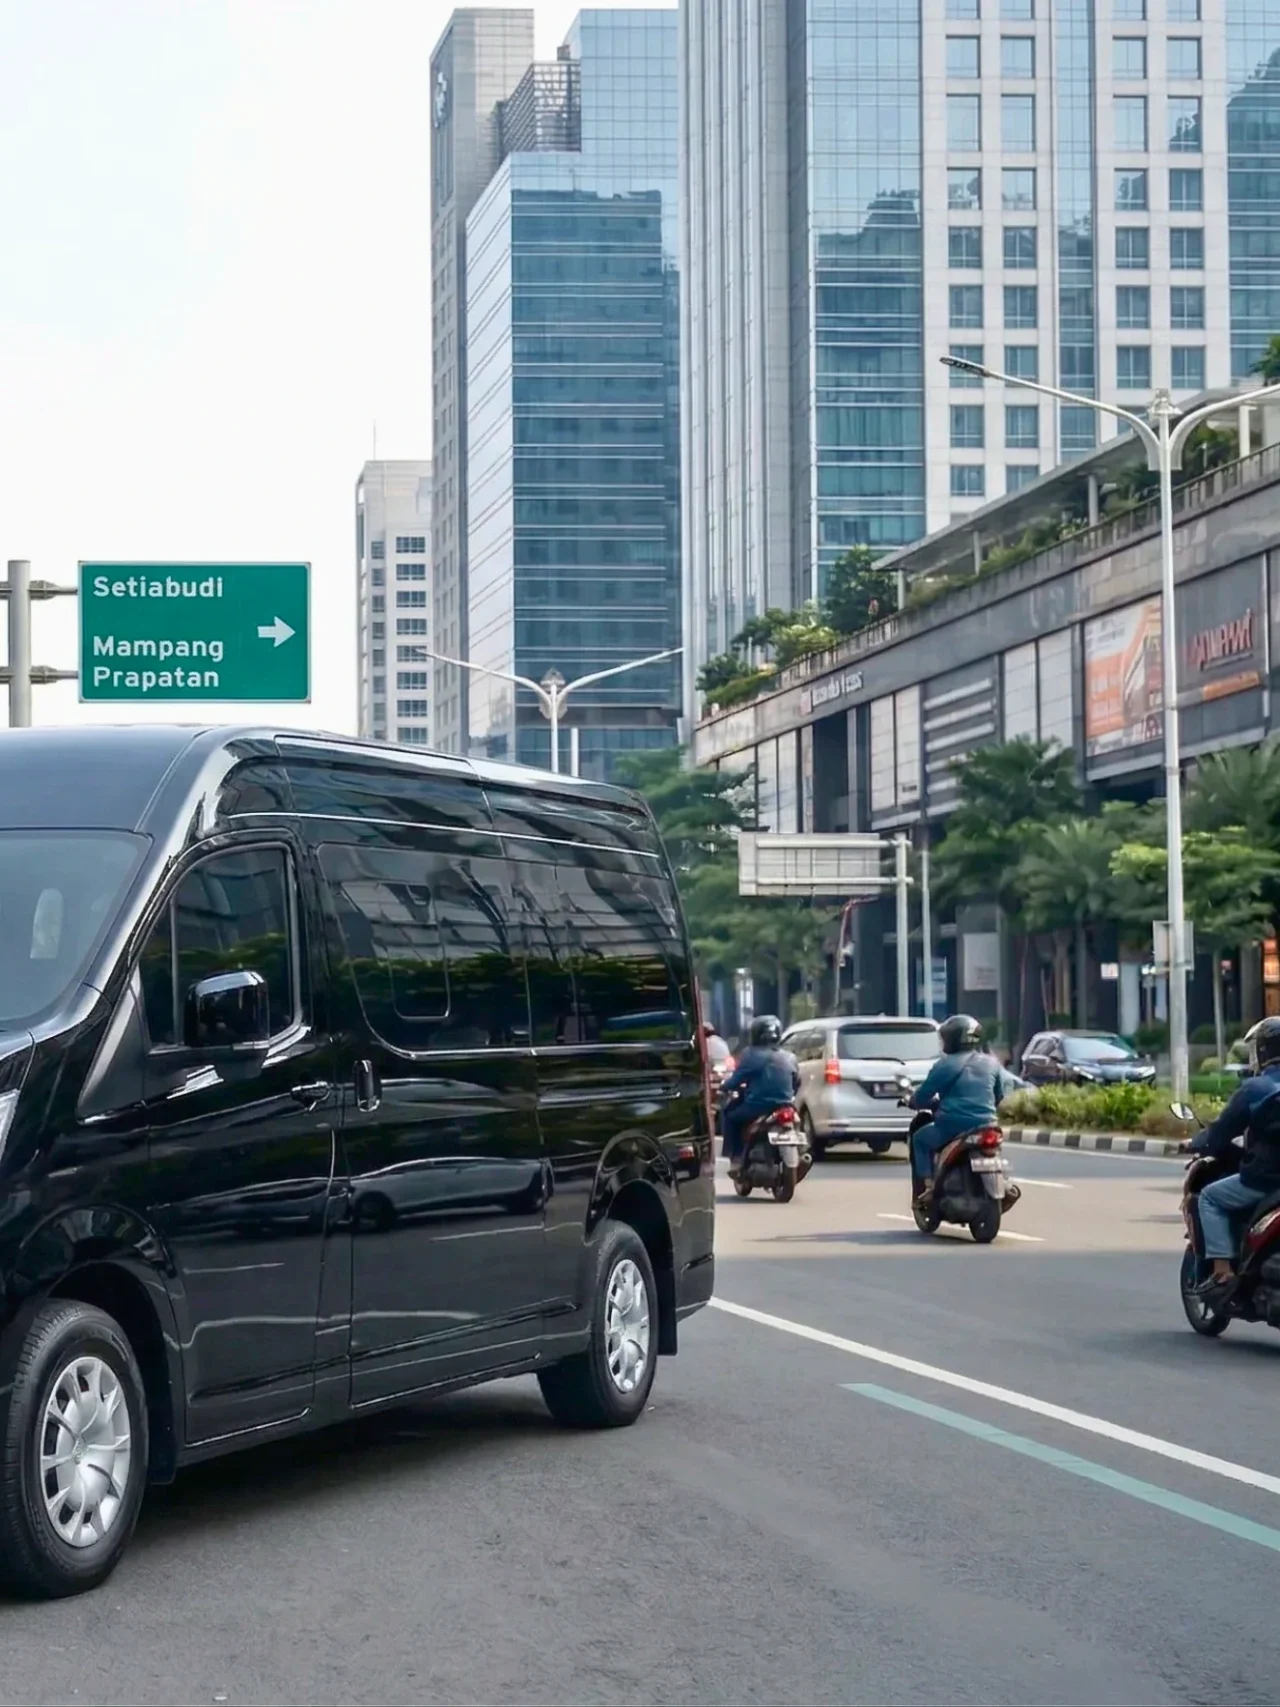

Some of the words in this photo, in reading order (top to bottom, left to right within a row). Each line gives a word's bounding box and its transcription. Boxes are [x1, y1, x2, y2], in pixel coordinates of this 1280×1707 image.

[93, 576, 223, 598] Setiabudi
[93, 635, 224, 661] Mampang
[93, 666, 219, 691] Prapatan
